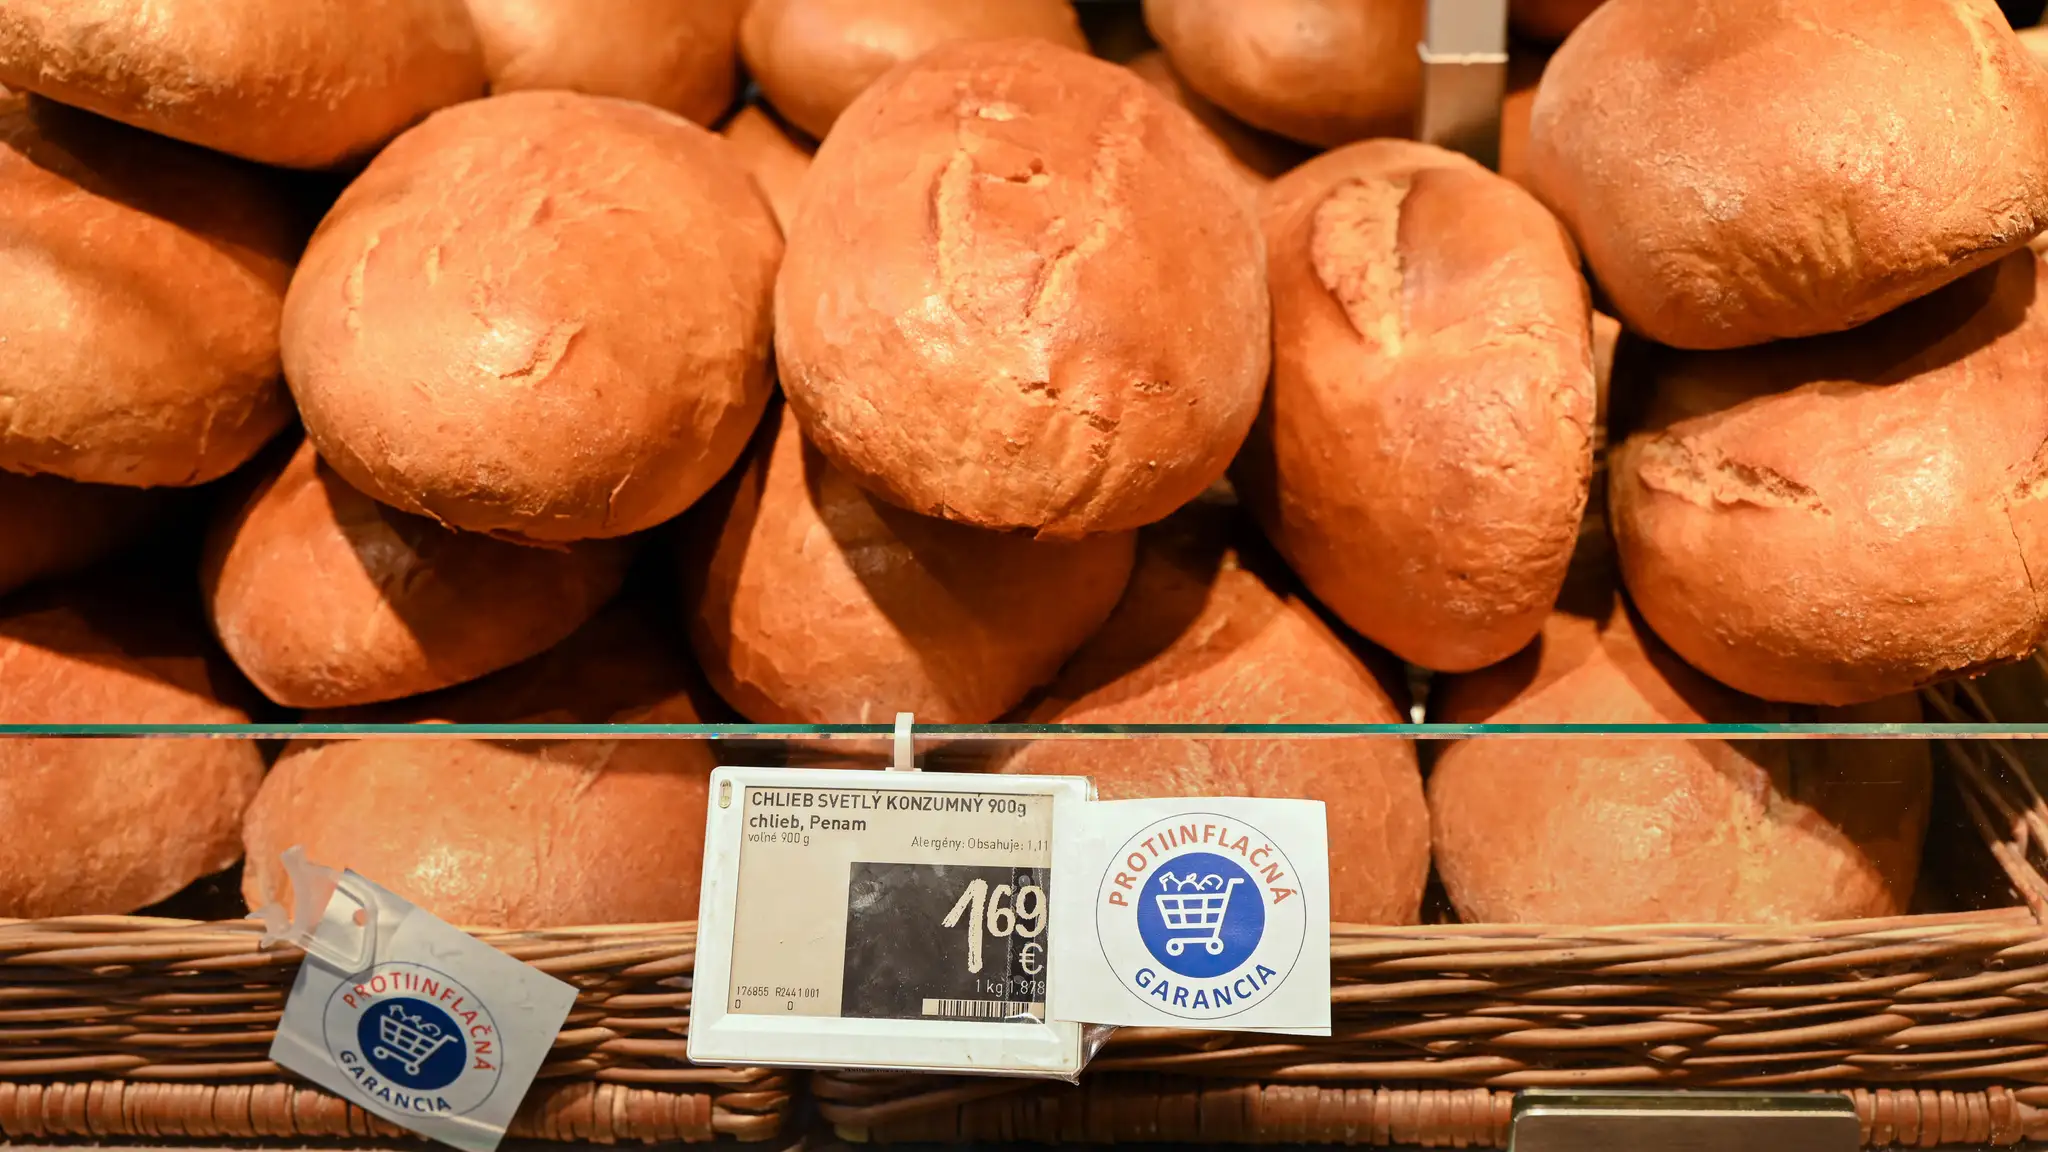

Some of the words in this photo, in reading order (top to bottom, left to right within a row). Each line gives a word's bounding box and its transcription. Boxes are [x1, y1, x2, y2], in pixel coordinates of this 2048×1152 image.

[752, 791, 814, 808] CHLIEB
[818, 790, 882, 810] SVETLÝ
[886, 793, 983, 813] KONZUMNÝ
[988, 799, 1027, 818] 900g
[749, 813, 804, 832] chlieb,
[810, 815, 867, 831] Penam
[748, 832, 777, 843] voľné
[781, 832, 801, 844] 900
[803, 835, 810, 847] g
[911, 836, 965, 851] Alergény:
[967, 837, 1024, 853] Obsahuje:
[1108, 823, 1298, 908] PROTIINFLAČNÁ
[1018, 942, 1044, 975] €
[736, 985, 769, 997] 176855
[975, 978, 981, 993] 1
[986, 979, 1003, 998] kg
[1134, 963, 1277, 1010] GARANCIA
[342, 971, 497, 1072] PROTIINFLAČNÁ
[339, 1049, 453, 1113] GARANCIA
